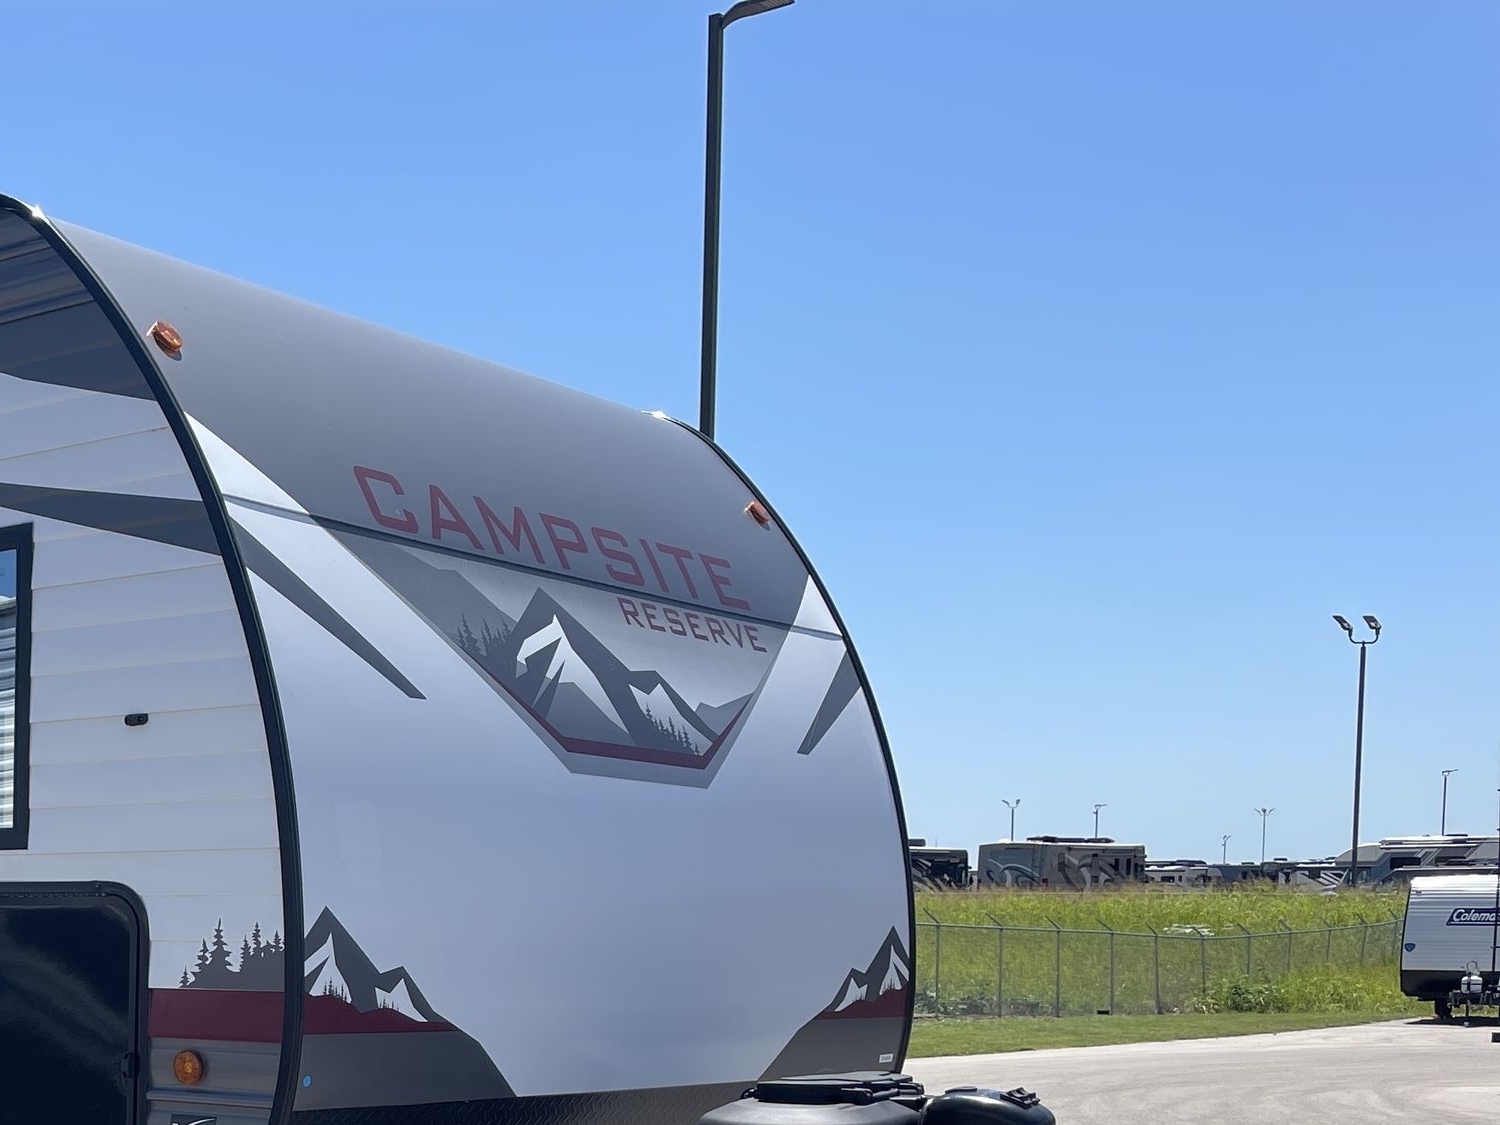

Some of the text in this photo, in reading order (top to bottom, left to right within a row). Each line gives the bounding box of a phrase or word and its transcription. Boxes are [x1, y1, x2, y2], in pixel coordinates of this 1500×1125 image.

[353, 465, 751, 611] CAMPSITE
[616, 596, 768, 653] RESERVE
[1452, 909, 1500, 922] Colema
